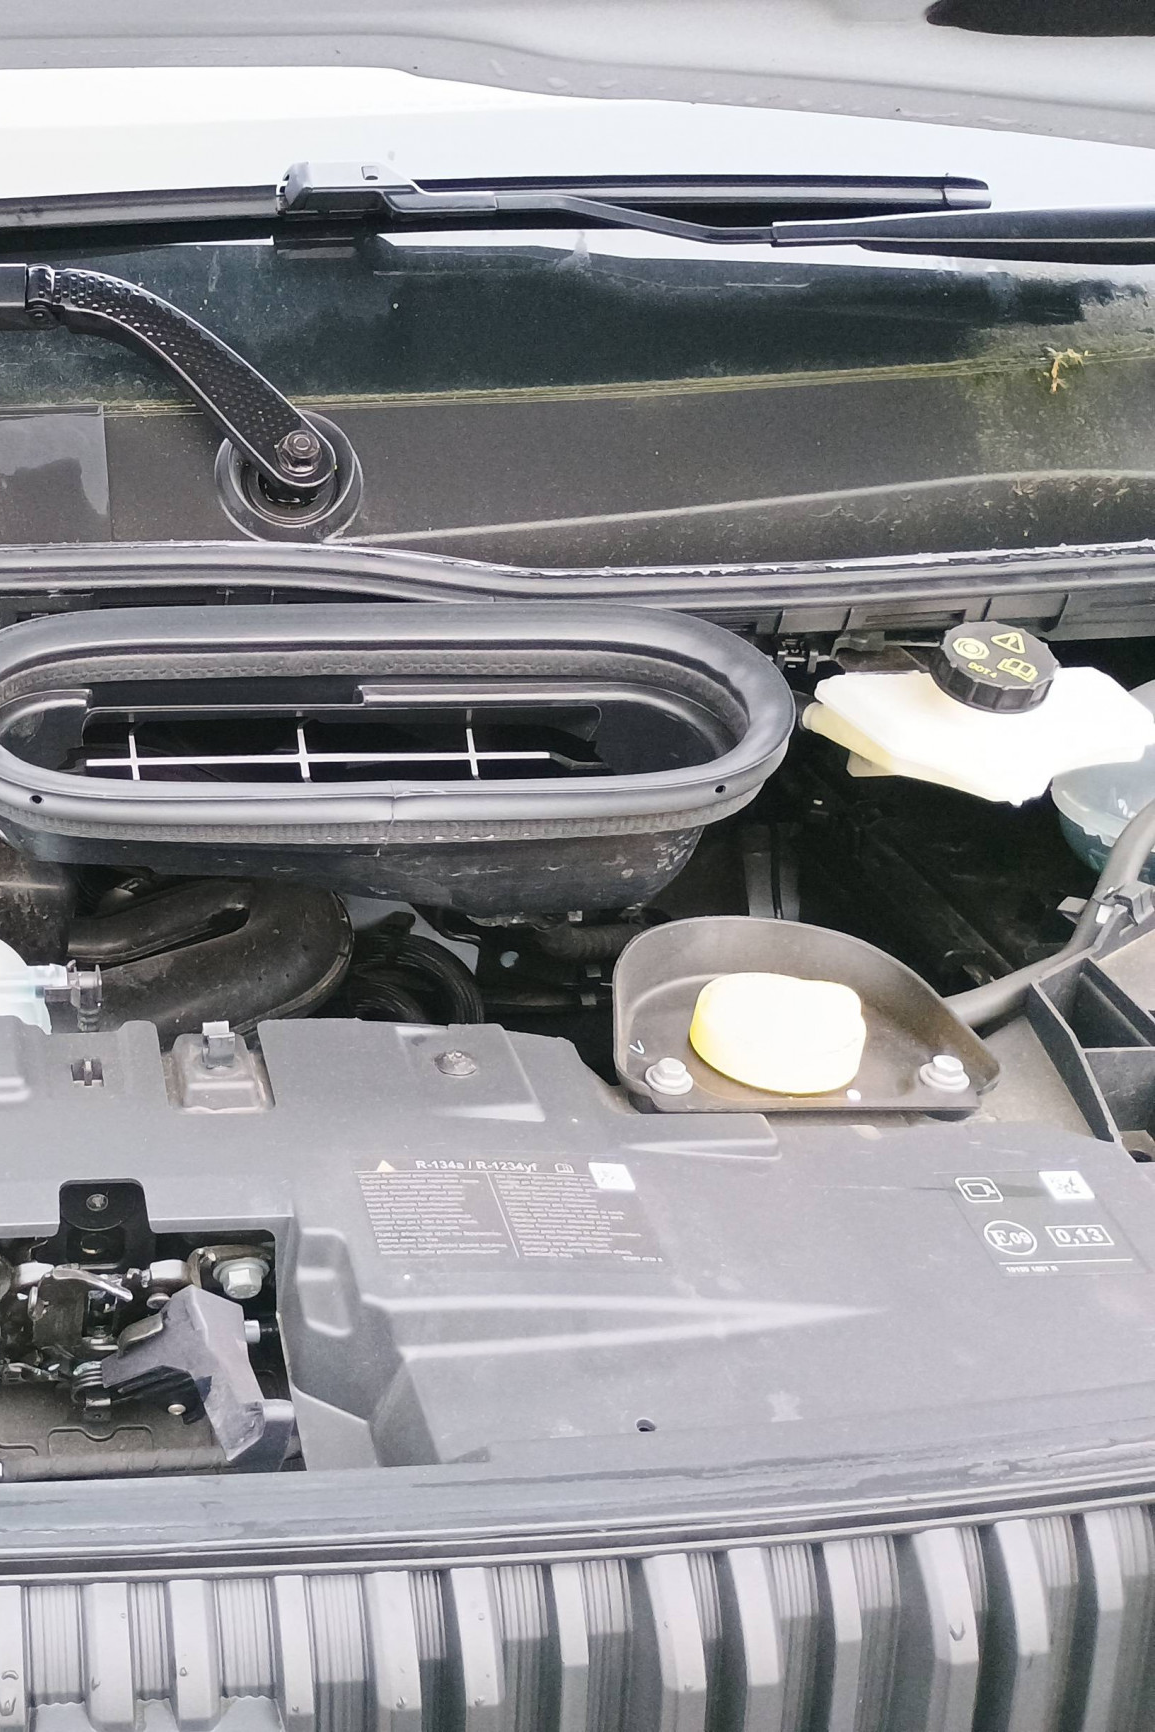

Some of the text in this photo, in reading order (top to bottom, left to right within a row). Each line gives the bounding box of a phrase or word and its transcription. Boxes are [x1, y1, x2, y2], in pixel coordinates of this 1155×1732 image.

[967, 662, 991, 674] DOT
[415, 1159, 465, 1170] R-134a
[476, 1160, 538, 1173] R-1234yf
[1055, 1228, 1104, 1244] 0,13
